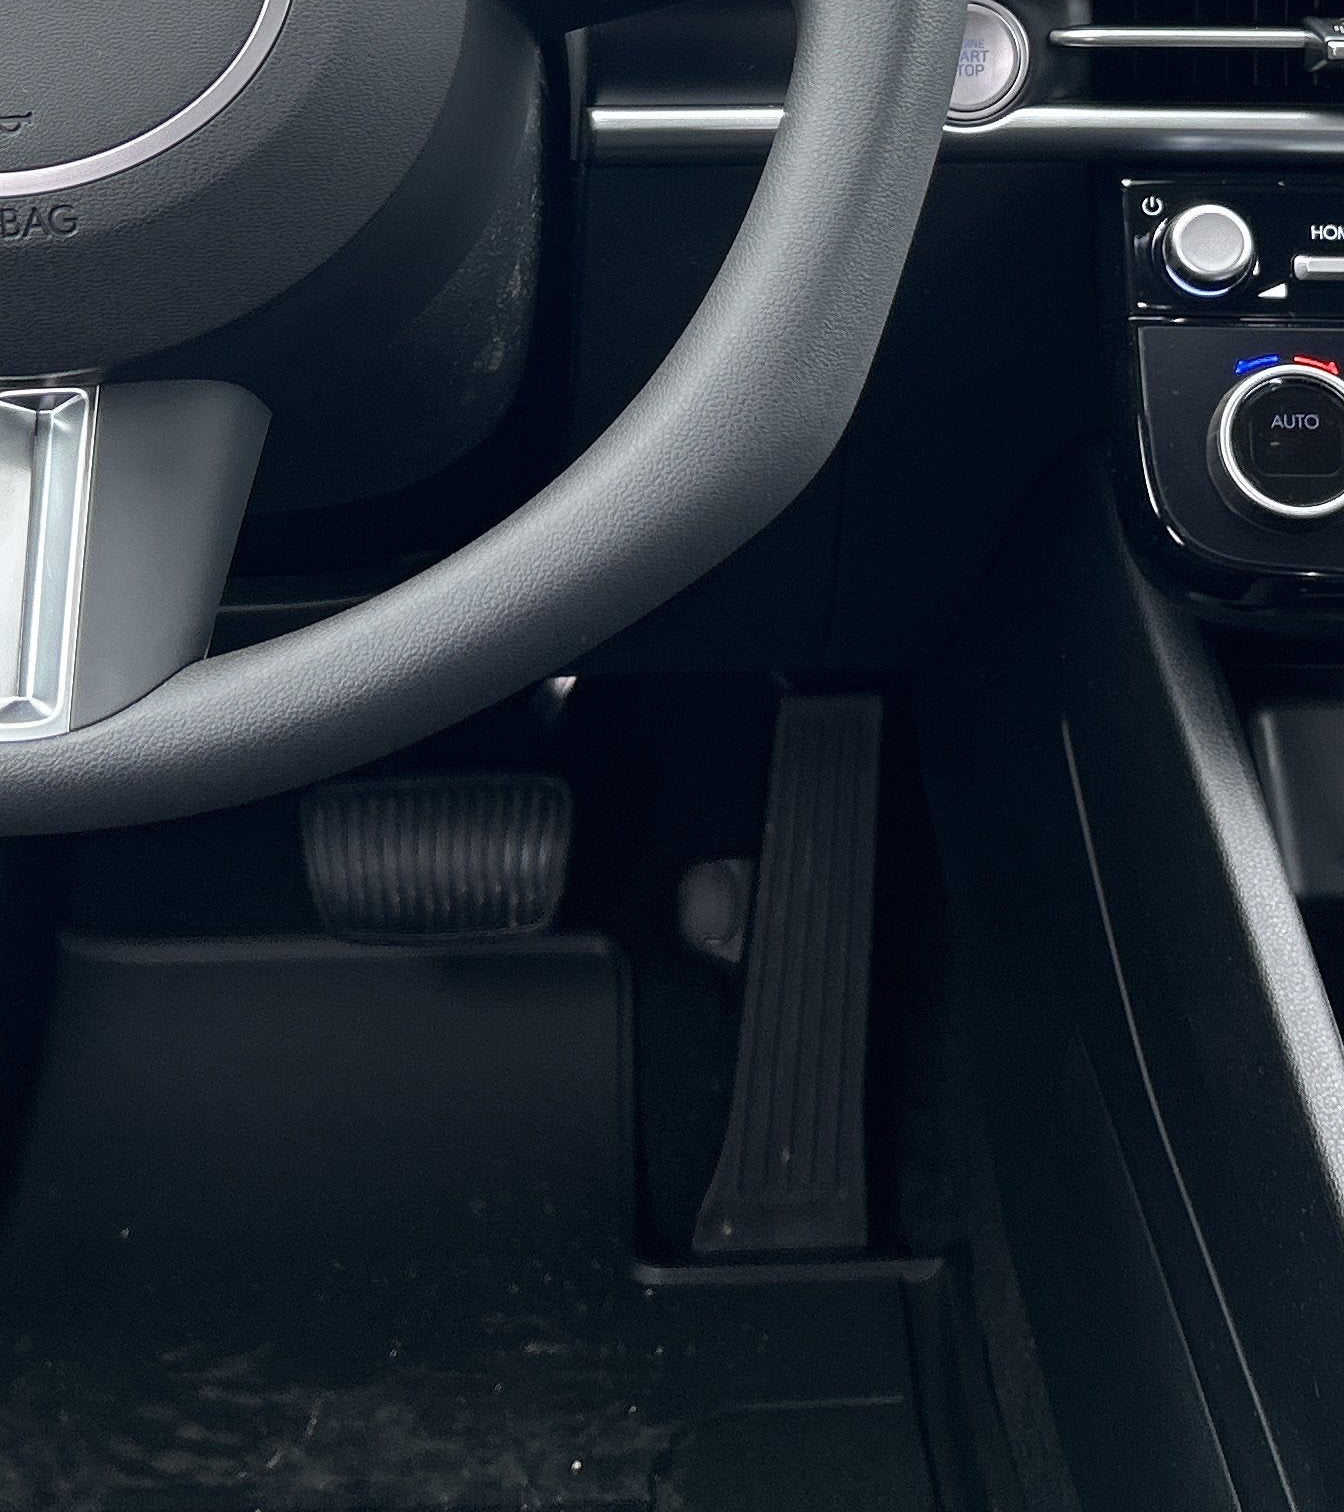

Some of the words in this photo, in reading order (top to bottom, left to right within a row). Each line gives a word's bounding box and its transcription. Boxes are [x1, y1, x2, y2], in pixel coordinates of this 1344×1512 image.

[959, 50, 989, 63] ART
[958, 64, 985, 77] TOP
[1270, 413, 1320, 430] AUTO
